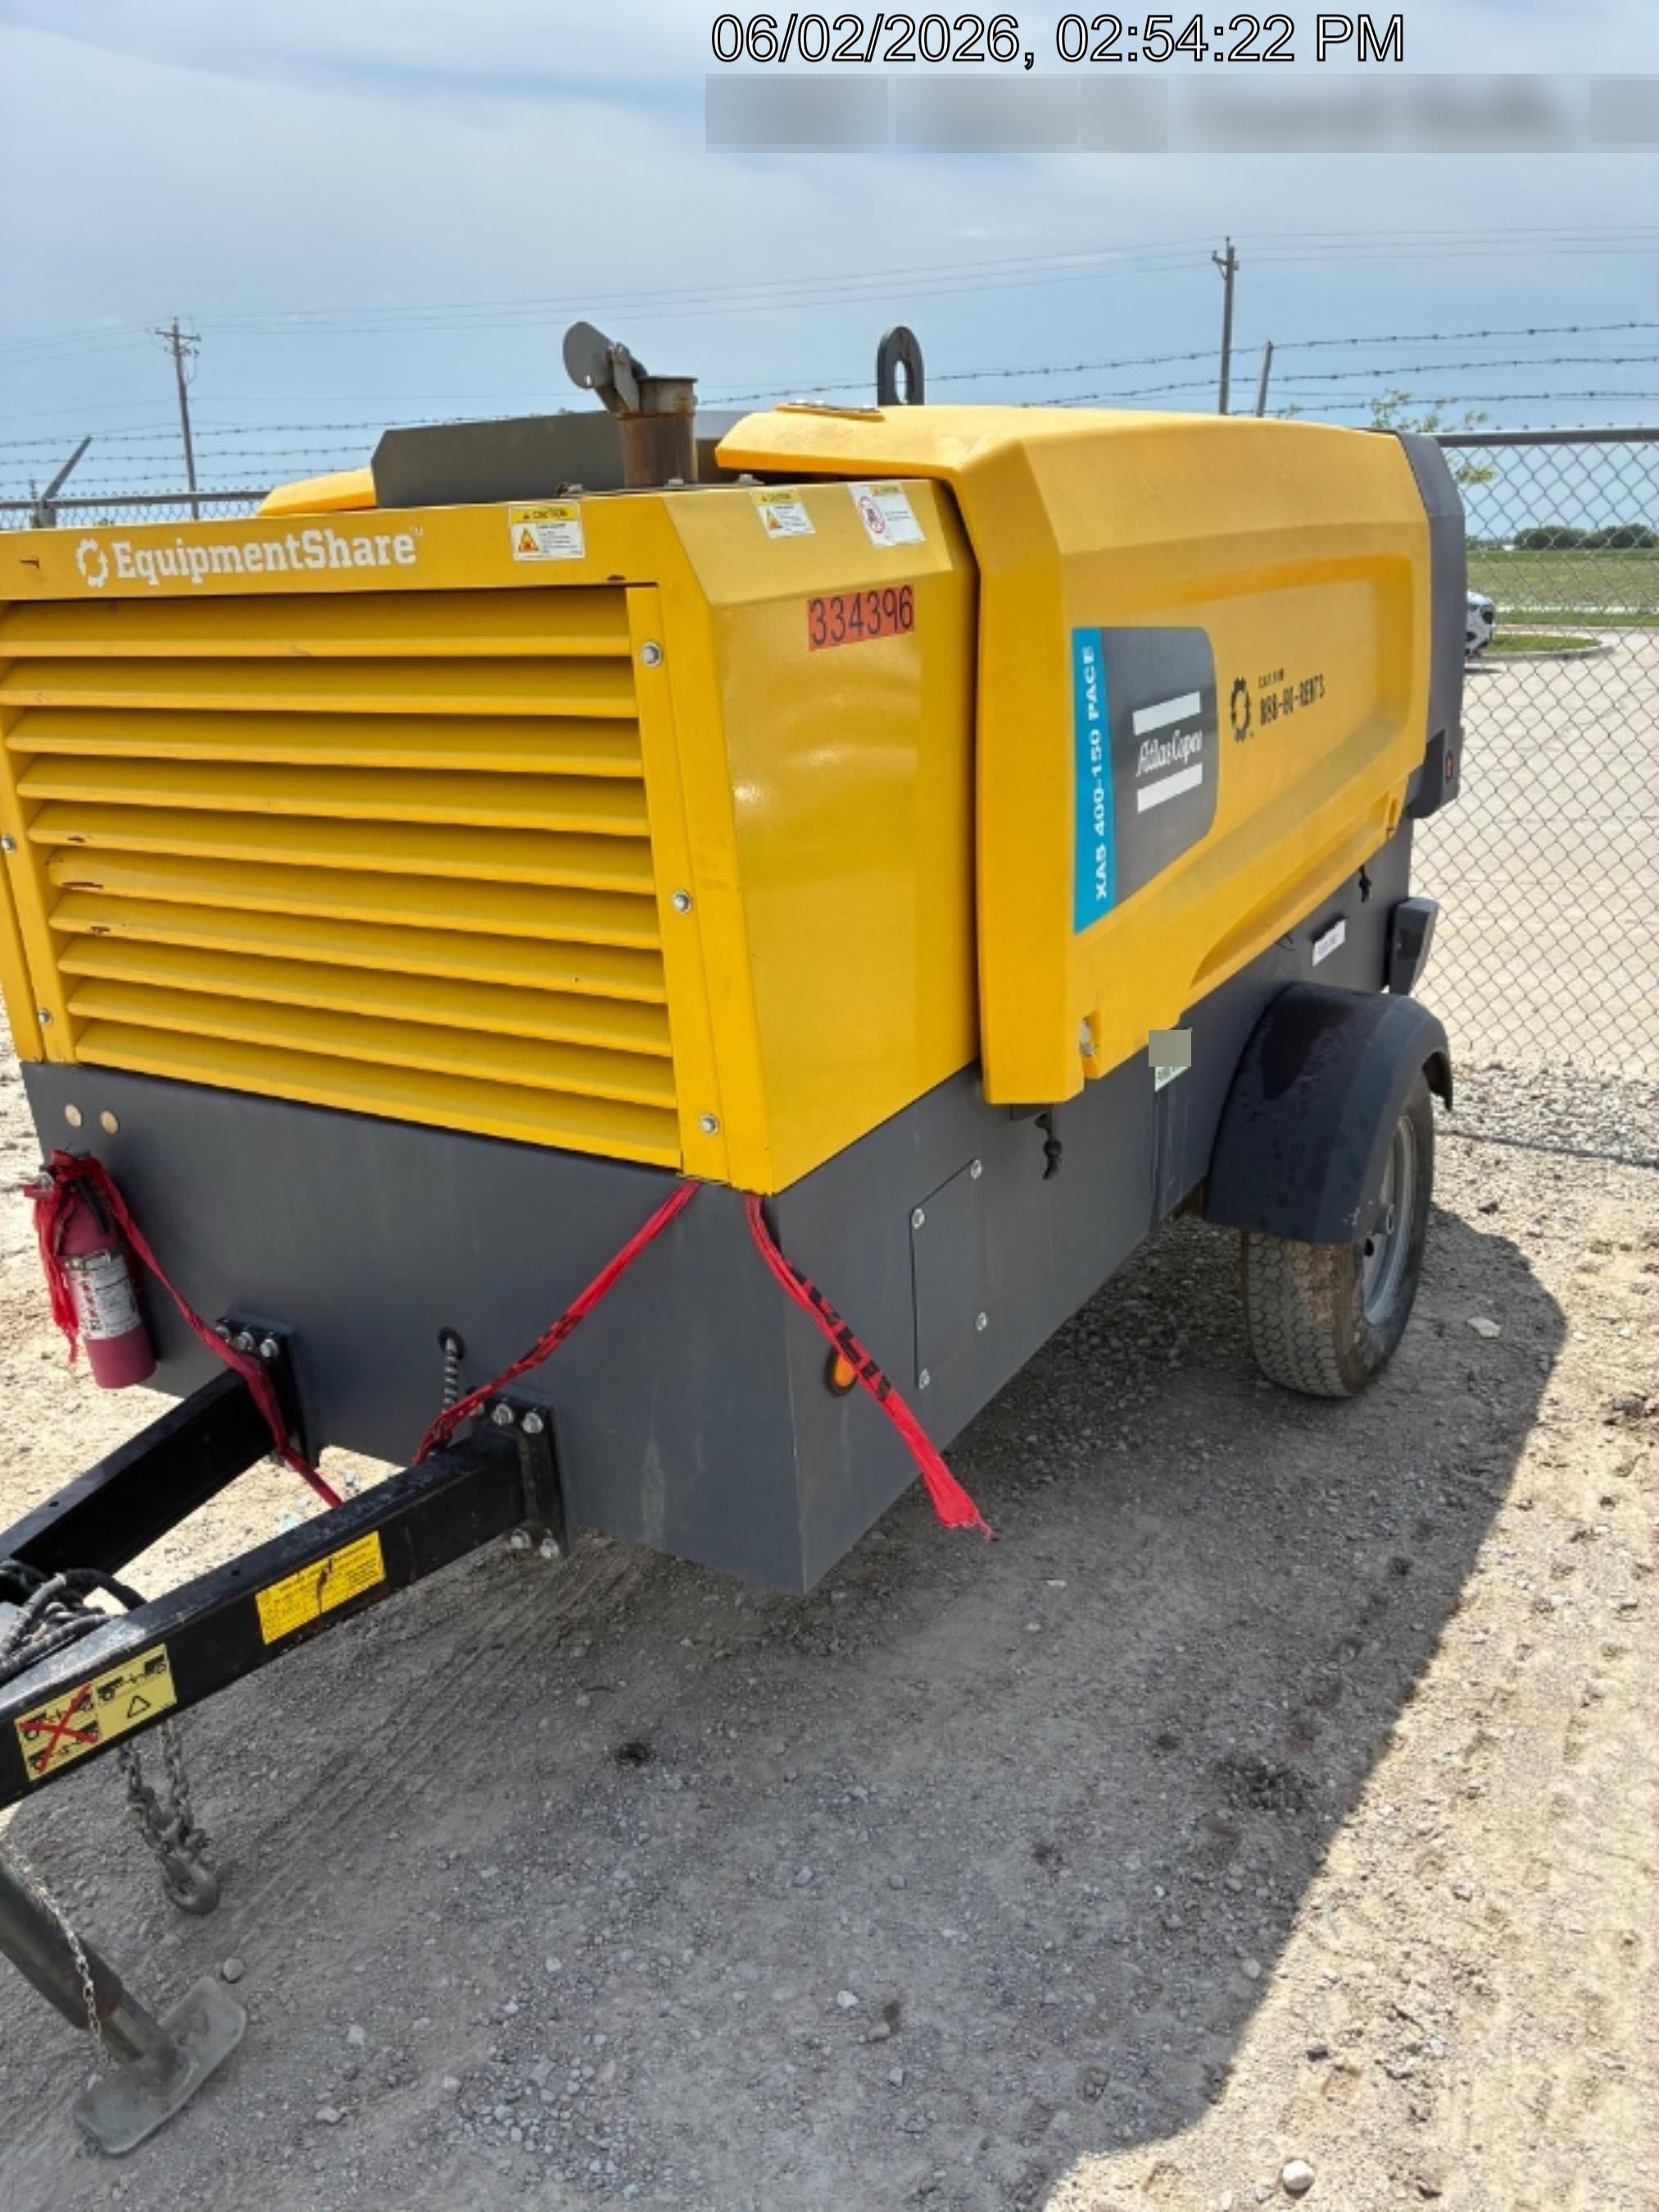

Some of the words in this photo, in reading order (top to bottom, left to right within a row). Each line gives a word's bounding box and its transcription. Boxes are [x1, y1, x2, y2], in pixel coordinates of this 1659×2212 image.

[112, 528, 416, 586] EquipmentShare
[810, 584, 913, 646] 334396
[1081, 646, 1099, 721] PACE
[1090, 729, 1105, 836] 400-150
